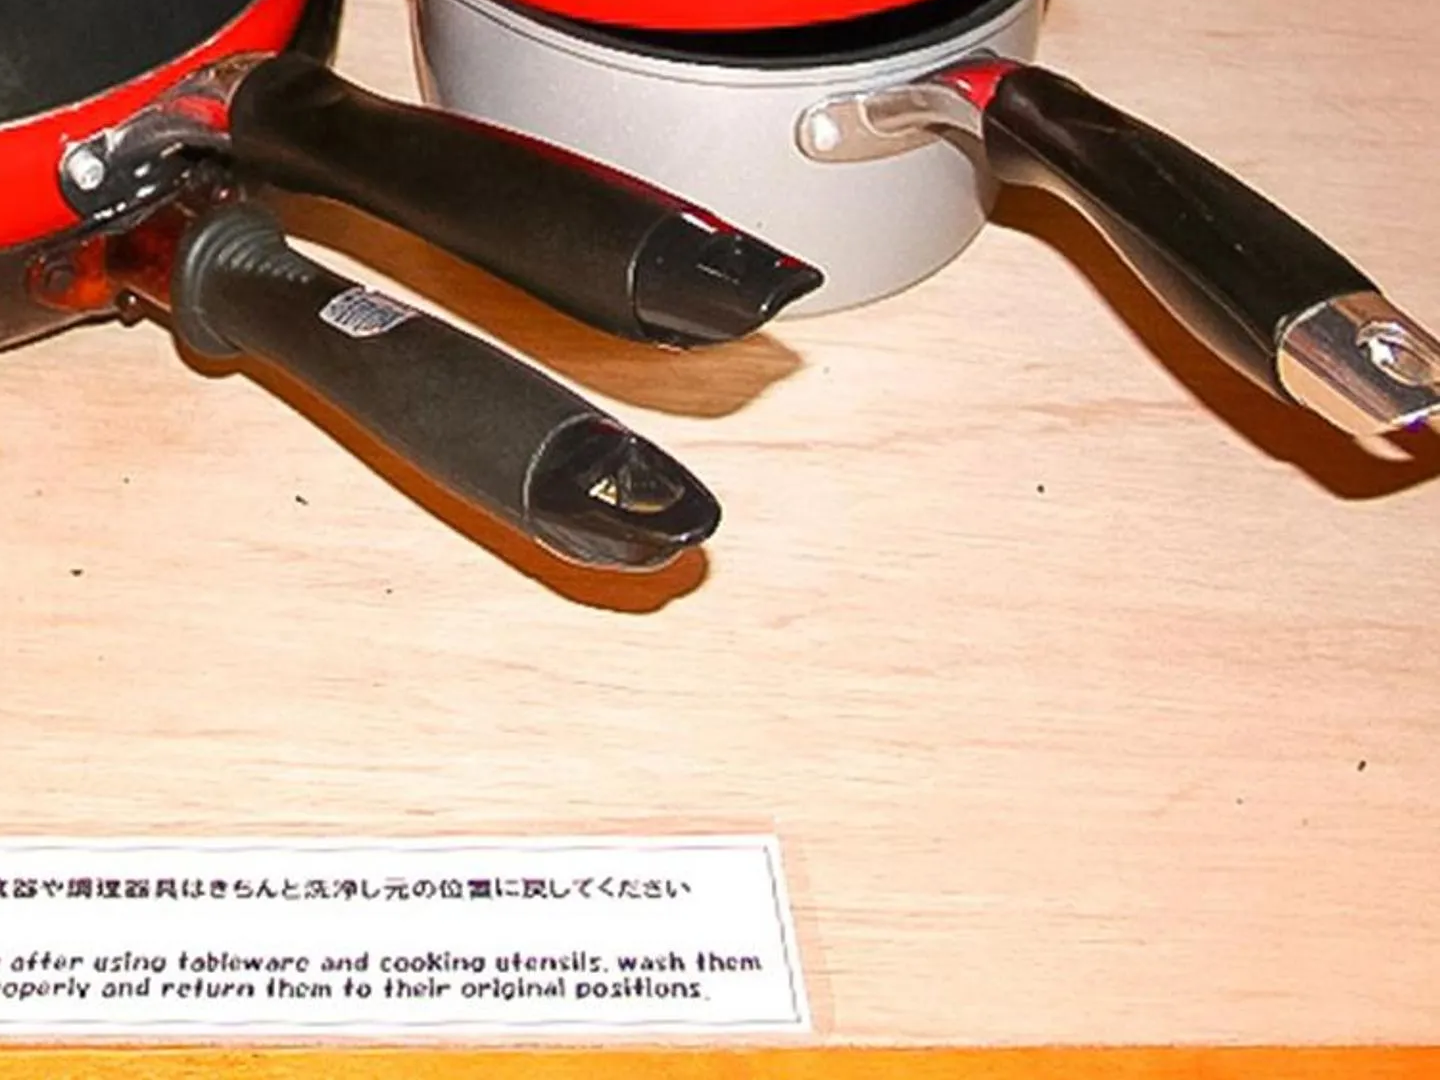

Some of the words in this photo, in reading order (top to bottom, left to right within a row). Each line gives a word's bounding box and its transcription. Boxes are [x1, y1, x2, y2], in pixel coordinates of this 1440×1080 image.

[10, 951, 84, 972] after
[93, 951, 167, 974] using
[178, 951, 310, 973] tableware
[320, 951, 369, 972] and
[379, 951, 486, 974] cooking
[617, 951, 686, 972] wash
[696, 951, 762, 972] them
[101, 976, 151, 999] and
[161, 978, 255, 999] return
[266, 977, 332, 999] them
[343, 977, 372, 999] to
[383, 977, 451, 999] their
[461, 977, 566, 1001] original
